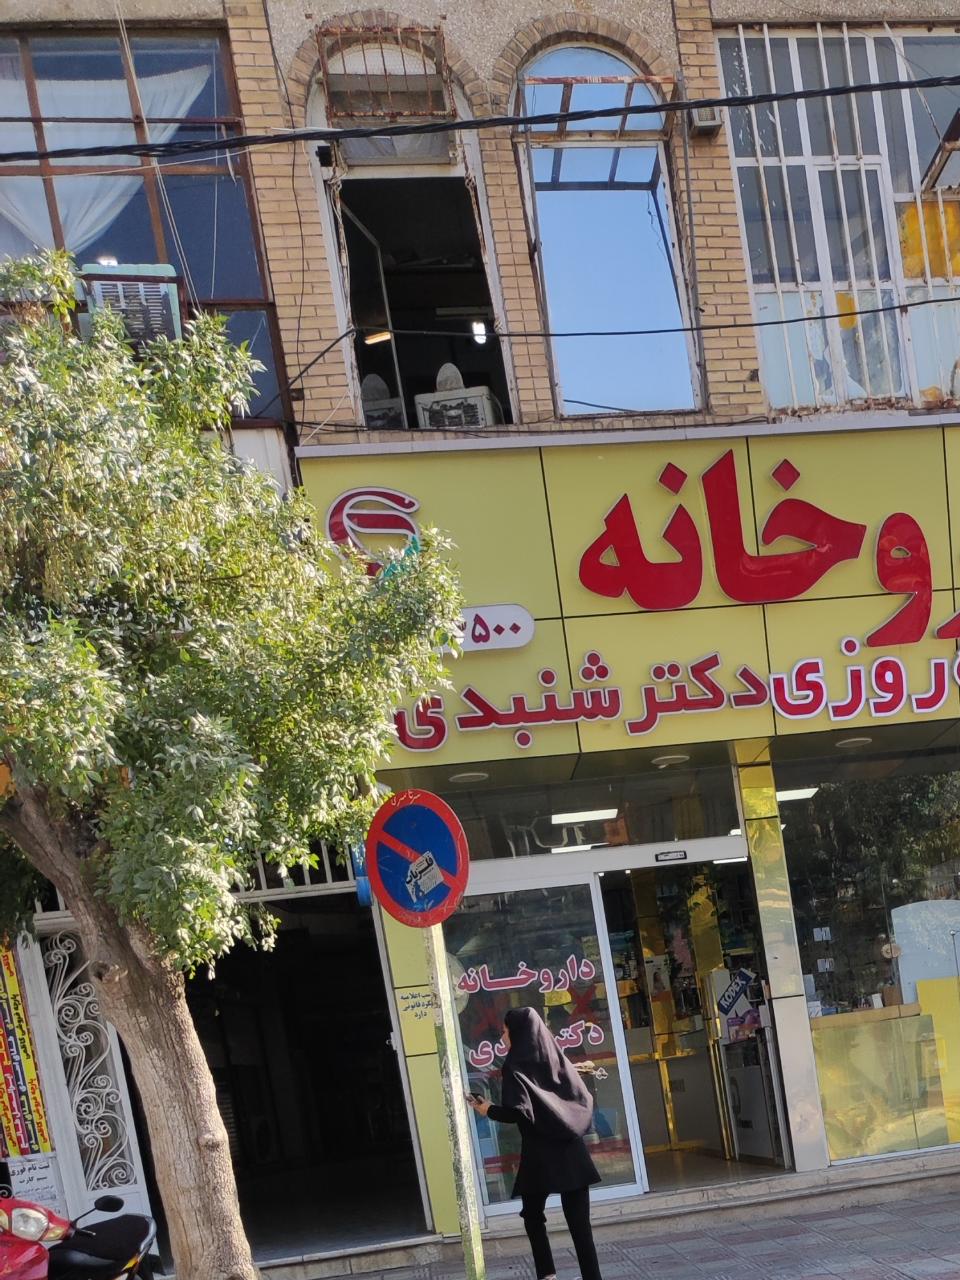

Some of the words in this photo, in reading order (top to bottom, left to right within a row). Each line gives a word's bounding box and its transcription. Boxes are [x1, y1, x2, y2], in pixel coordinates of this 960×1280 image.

[394, 650, 623, 751] شنبدی
[625, 651, 771, 735] دکتر
[769, 635, 950, 721] روزی
[457, 954, 596, 993] داروخانه
[719, 975, 747, 1009] KODEX
